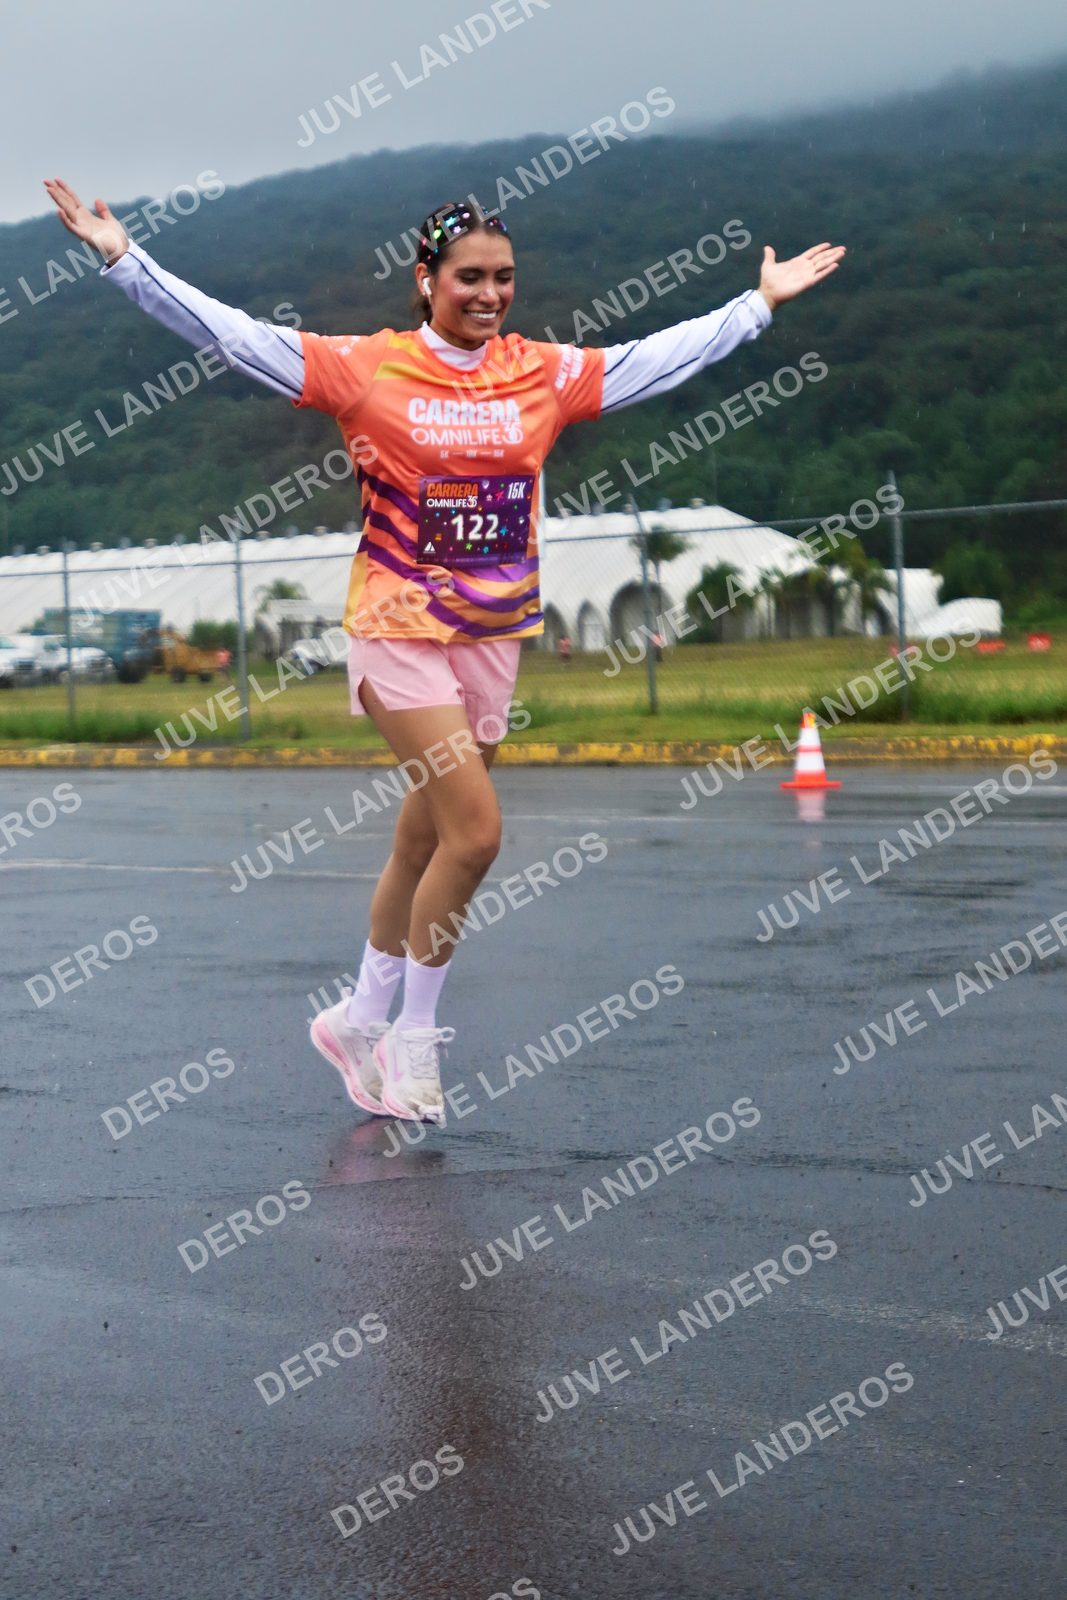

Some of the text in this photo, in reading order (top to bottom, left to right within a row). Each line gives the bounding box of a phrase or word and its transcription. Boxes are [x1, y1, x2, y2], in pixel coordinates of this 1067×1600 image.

[408, 398, 521, 425] CARRERA
[426, 483, 478, 498] CARRERA
[507, 482, 527, 500] 15K
[451, 514, 499, 541] 122
